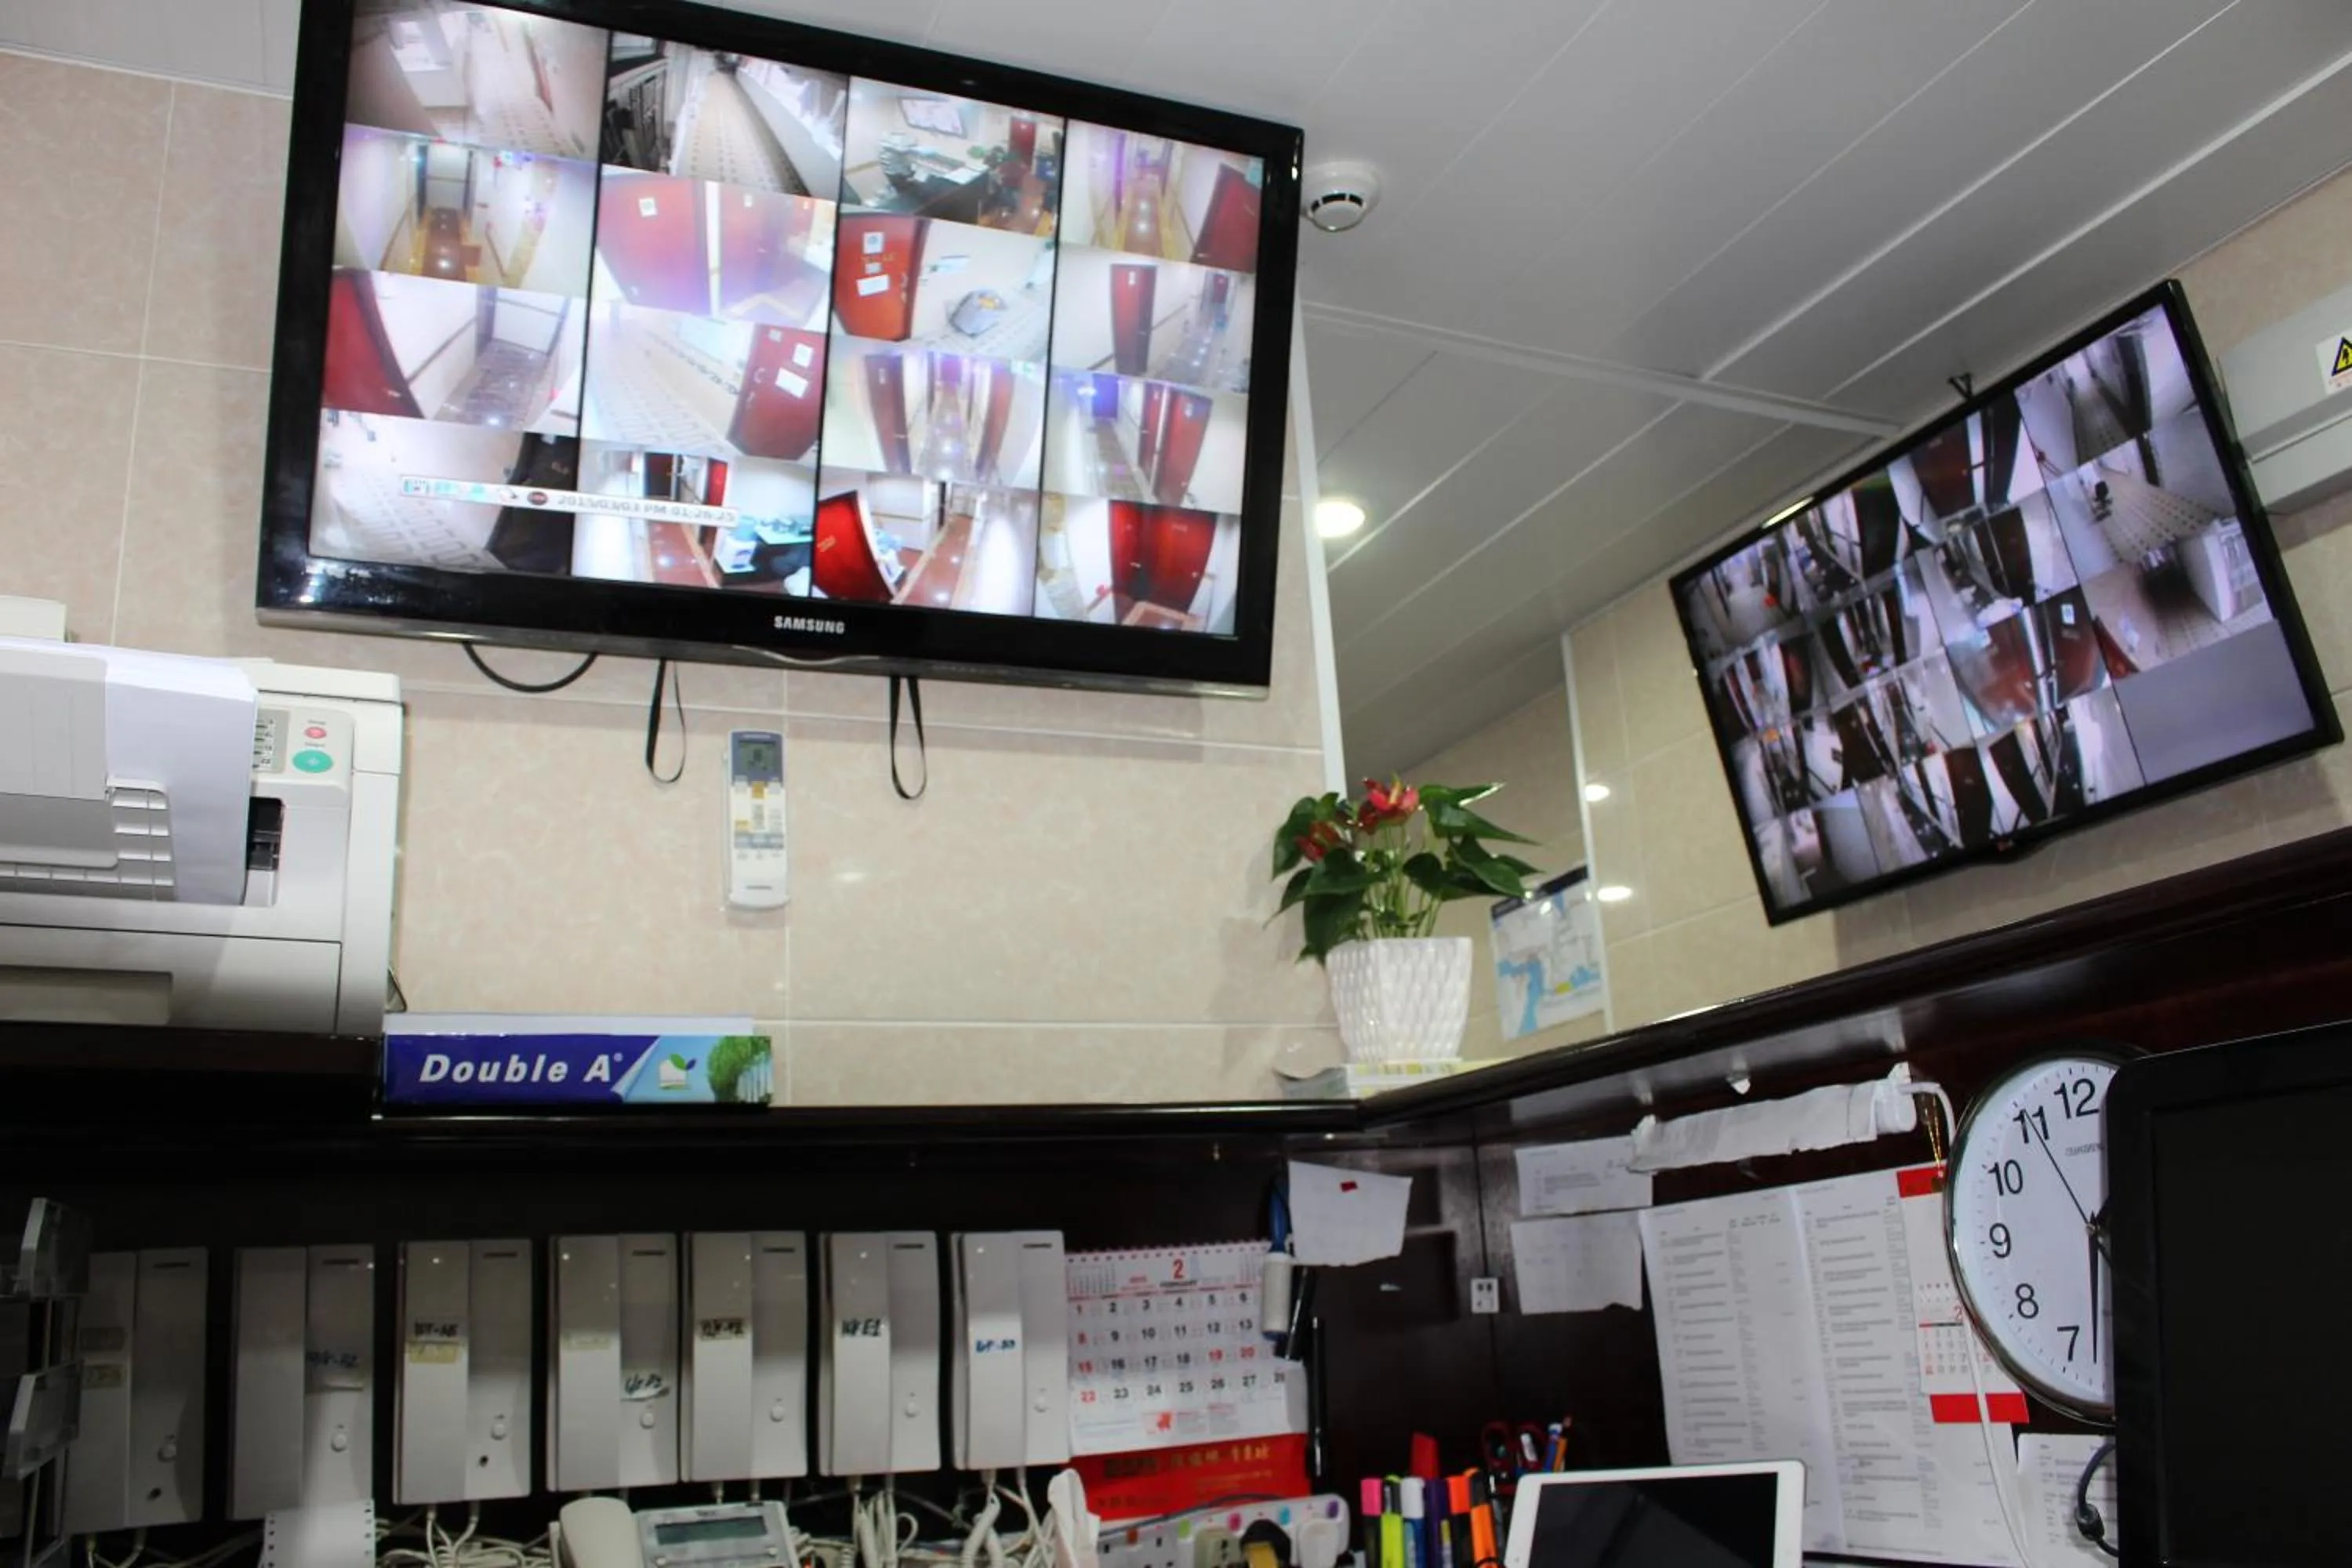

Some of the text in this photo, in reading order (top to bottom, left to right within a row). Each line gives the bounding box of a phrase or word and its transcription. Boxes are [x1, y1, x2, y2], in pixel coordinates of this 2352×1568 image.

[774, 615, 845, 634] SAMSUNG
[419, 1054, 568, 1083] Double
[2053, 1078, 2100, 1120] 12
[2013, 1105, 2050, 1144] 11
[1987, 1160, 2024, 1196] 10
[1989, 1223, 2012, 1258] 9
[1172, 1258, 1185, 1279] 2
[1108, 1301, 1118, 1313] 2
[1142, 1298, 1151, 1311] 3
[1174, 1295, 1184, 1307] 4
[2015, 1283, 2039, 1319] 8
[1109, 1329, 1121, 1343] 9
[1142, 1327, 1157, 1340] 10
[1174, 1325, 1188, 1338] 11
[1207, 1321, 1221, 1334] 12
[1239, 1318, 1254, 1330] 13
[2056, 1325, 2080, 1362] 7
[1111, 1357, 1127, 1370] 16
[1144, 1355, 1159, 1368] 17
[1176, 1352, 1192, 1365] 18
[1208, 1348, 1225, 1363] 19
[1240, 1345, 1256, 1359] 20
[1080, 1391, 1098, 1403] 22
[1113, 1387, 1130, 1399] 23
[1146, 1383, 1163, 1396] 24
[1179, 1380, 1196, 1393] 25
[1210, 1377, 1226, 1390] 26
[1242, 1374, 1258, 1387] 27
